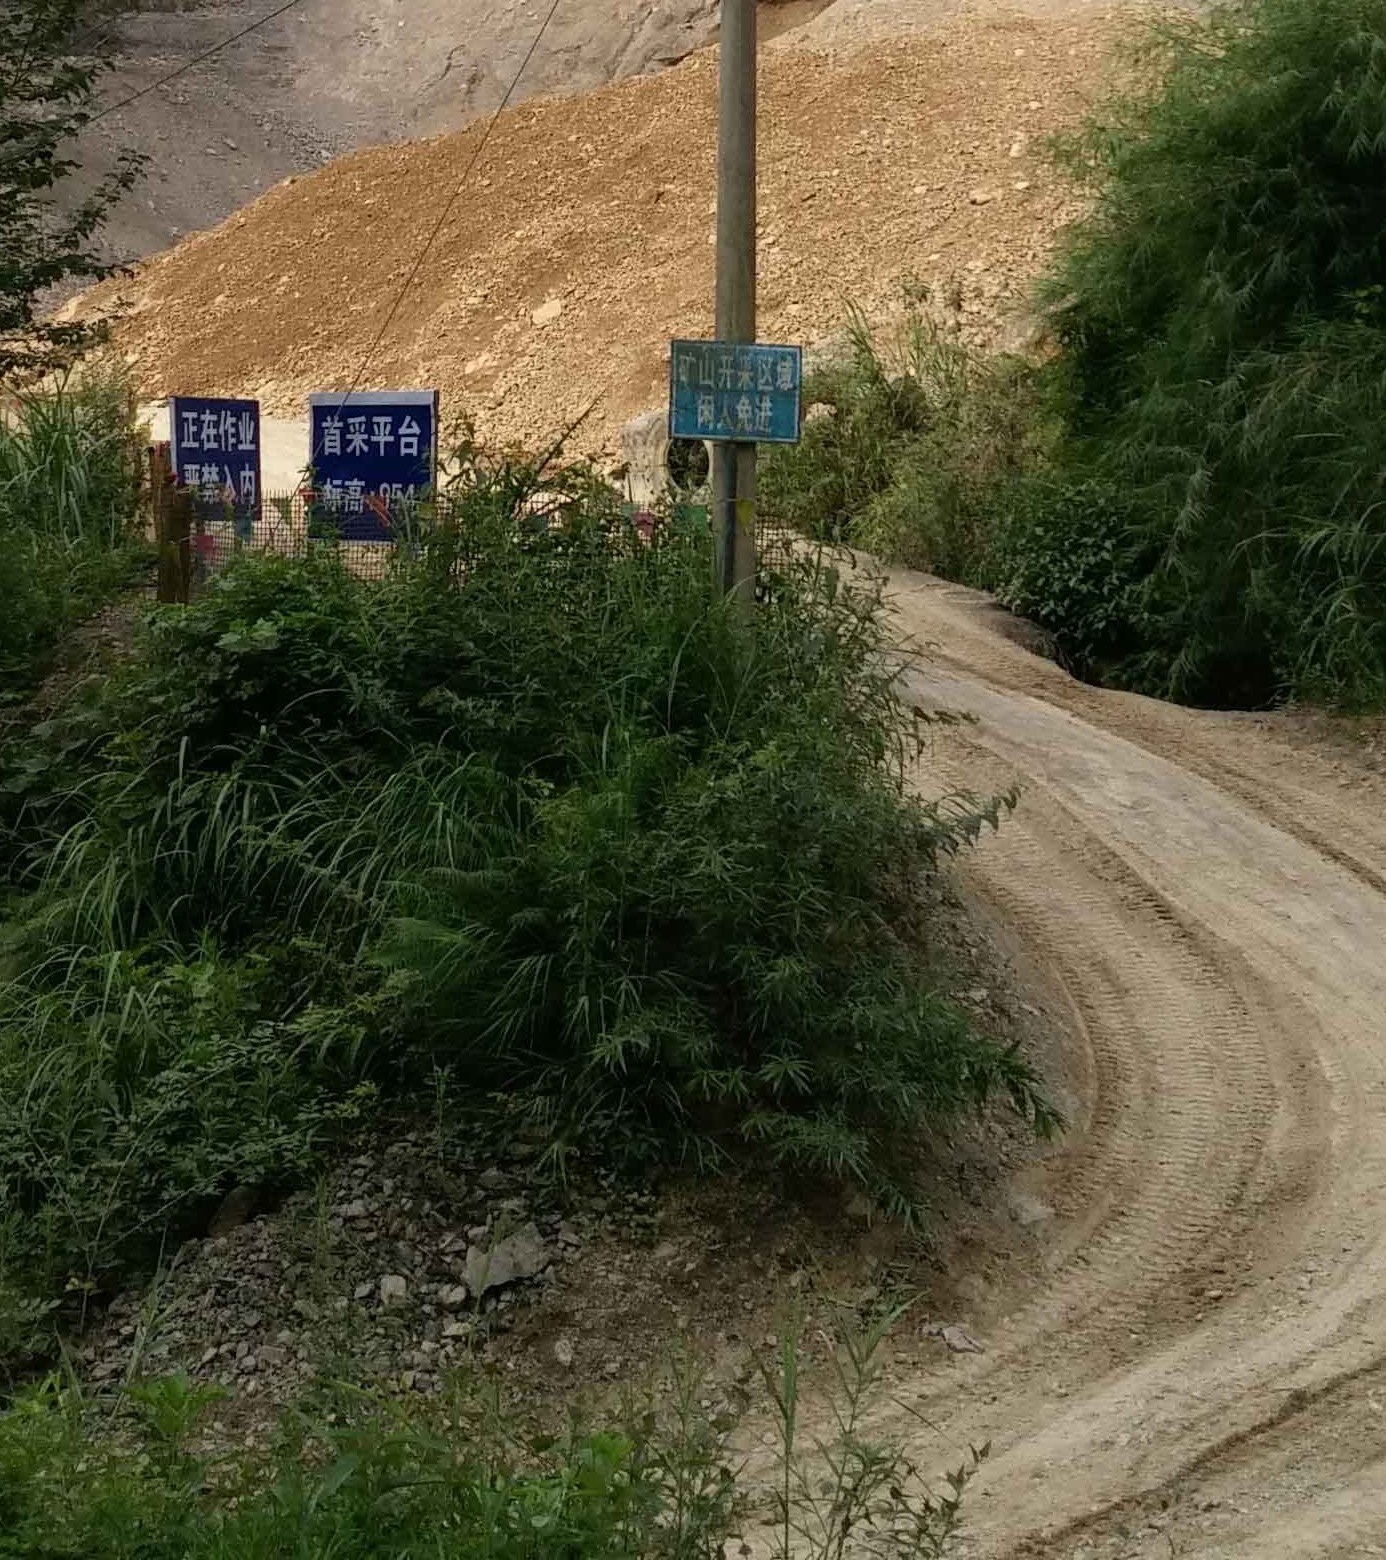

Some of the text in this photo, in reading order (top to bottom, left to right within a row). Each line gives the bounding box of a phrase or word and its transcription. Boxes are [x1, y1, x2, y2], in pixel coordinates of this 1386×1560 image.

[678, 351, 794, 391] 矿山开采区域
[180, 409, 256, 452] 正在作业
[321, 415, 422, 457] 首采平台
[182, 462, 256, 505] 严禁入内
